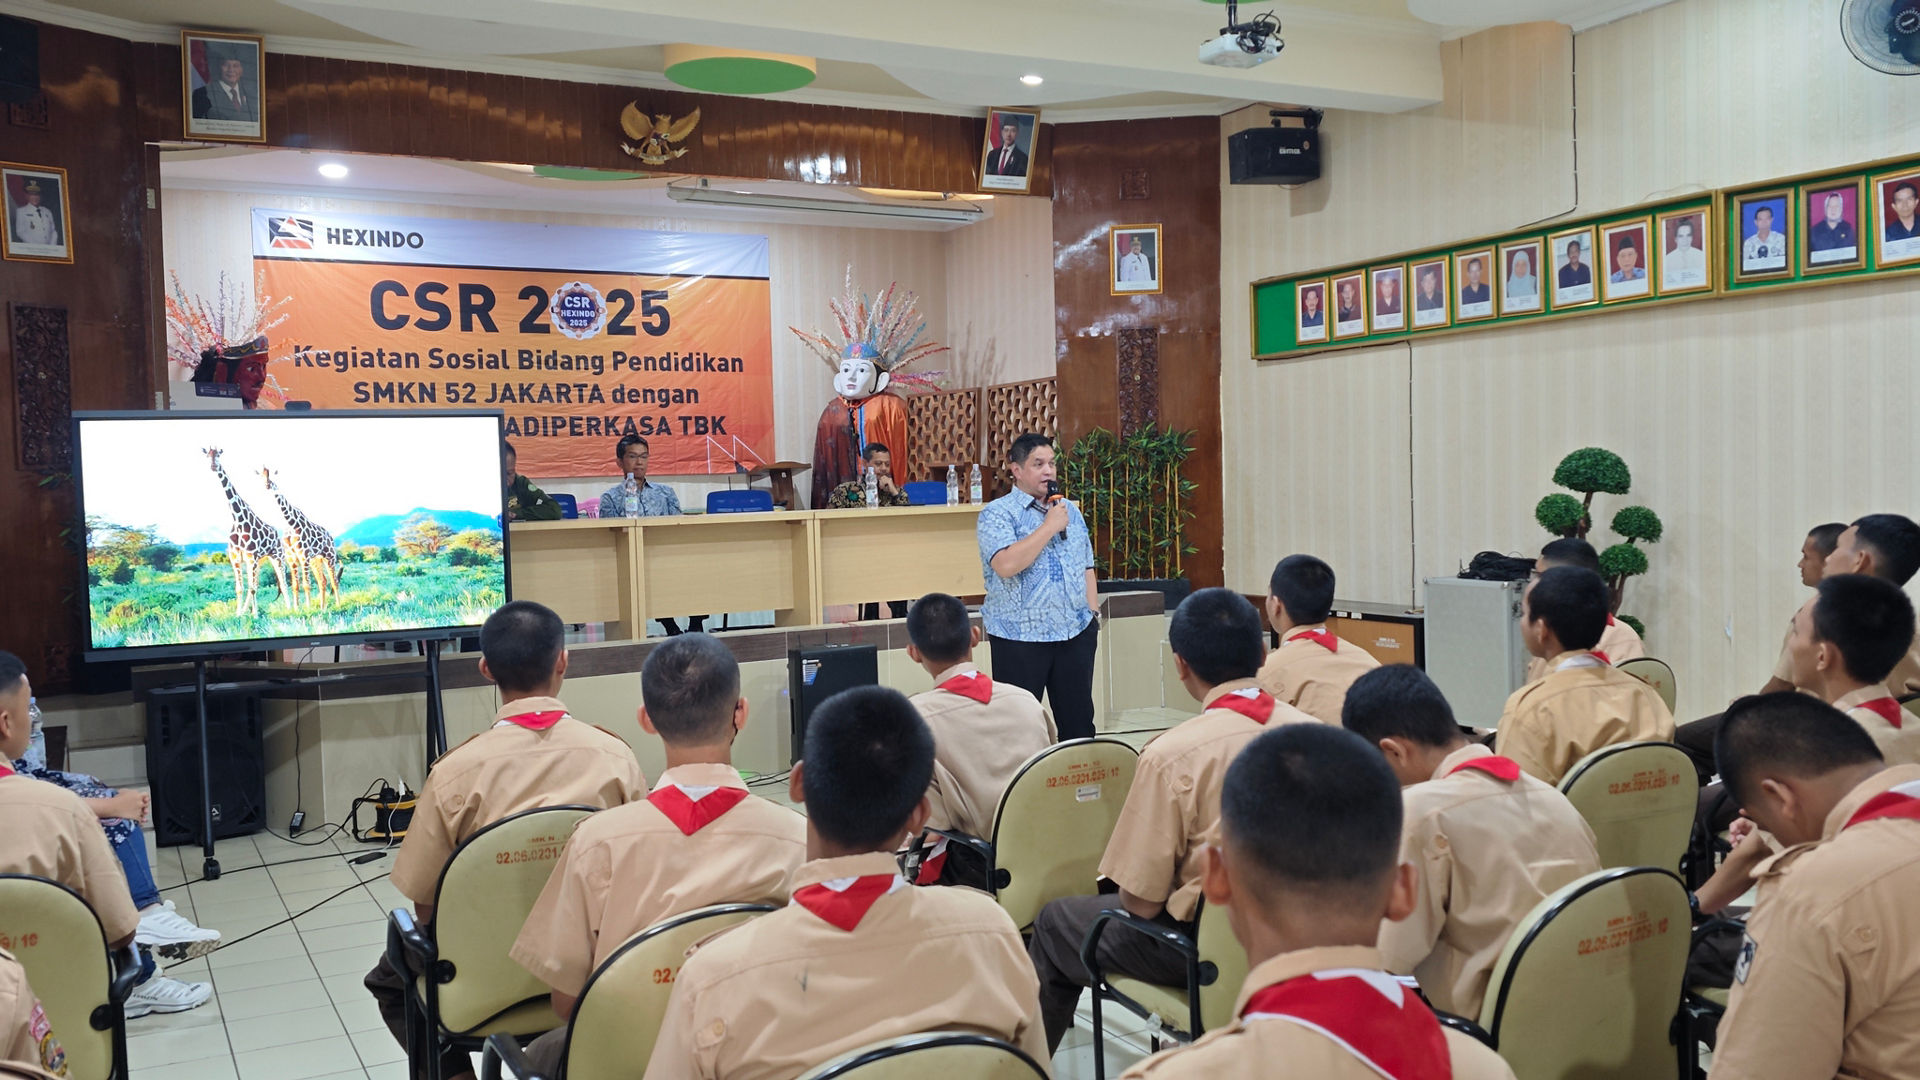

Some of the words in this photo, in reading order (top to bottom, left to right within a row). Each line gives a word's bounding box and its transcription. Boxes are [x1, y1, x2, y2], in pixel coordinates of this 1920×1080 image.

[327, 228, 424, 249] HEXINDO
[370, 280, 499, 332] CSR
[564, 296, 590, 308] CSR
[561, 310, 596, 318] HEXINDO
[294, 345, 420, 373] Kegiatan
[428, 348, 510, 370] Sosial
[518, 349, 604, 376] Bidang
[613, 351, 744, 373] Pendidikan
[353, 381, 437, 404] SMKN
[445, 382, 477, 404] 52
[484, 382, 606, 404] JAKARTA
[611, 384, 699, 409] dengan
[678, 415, 727, 436] TBK
